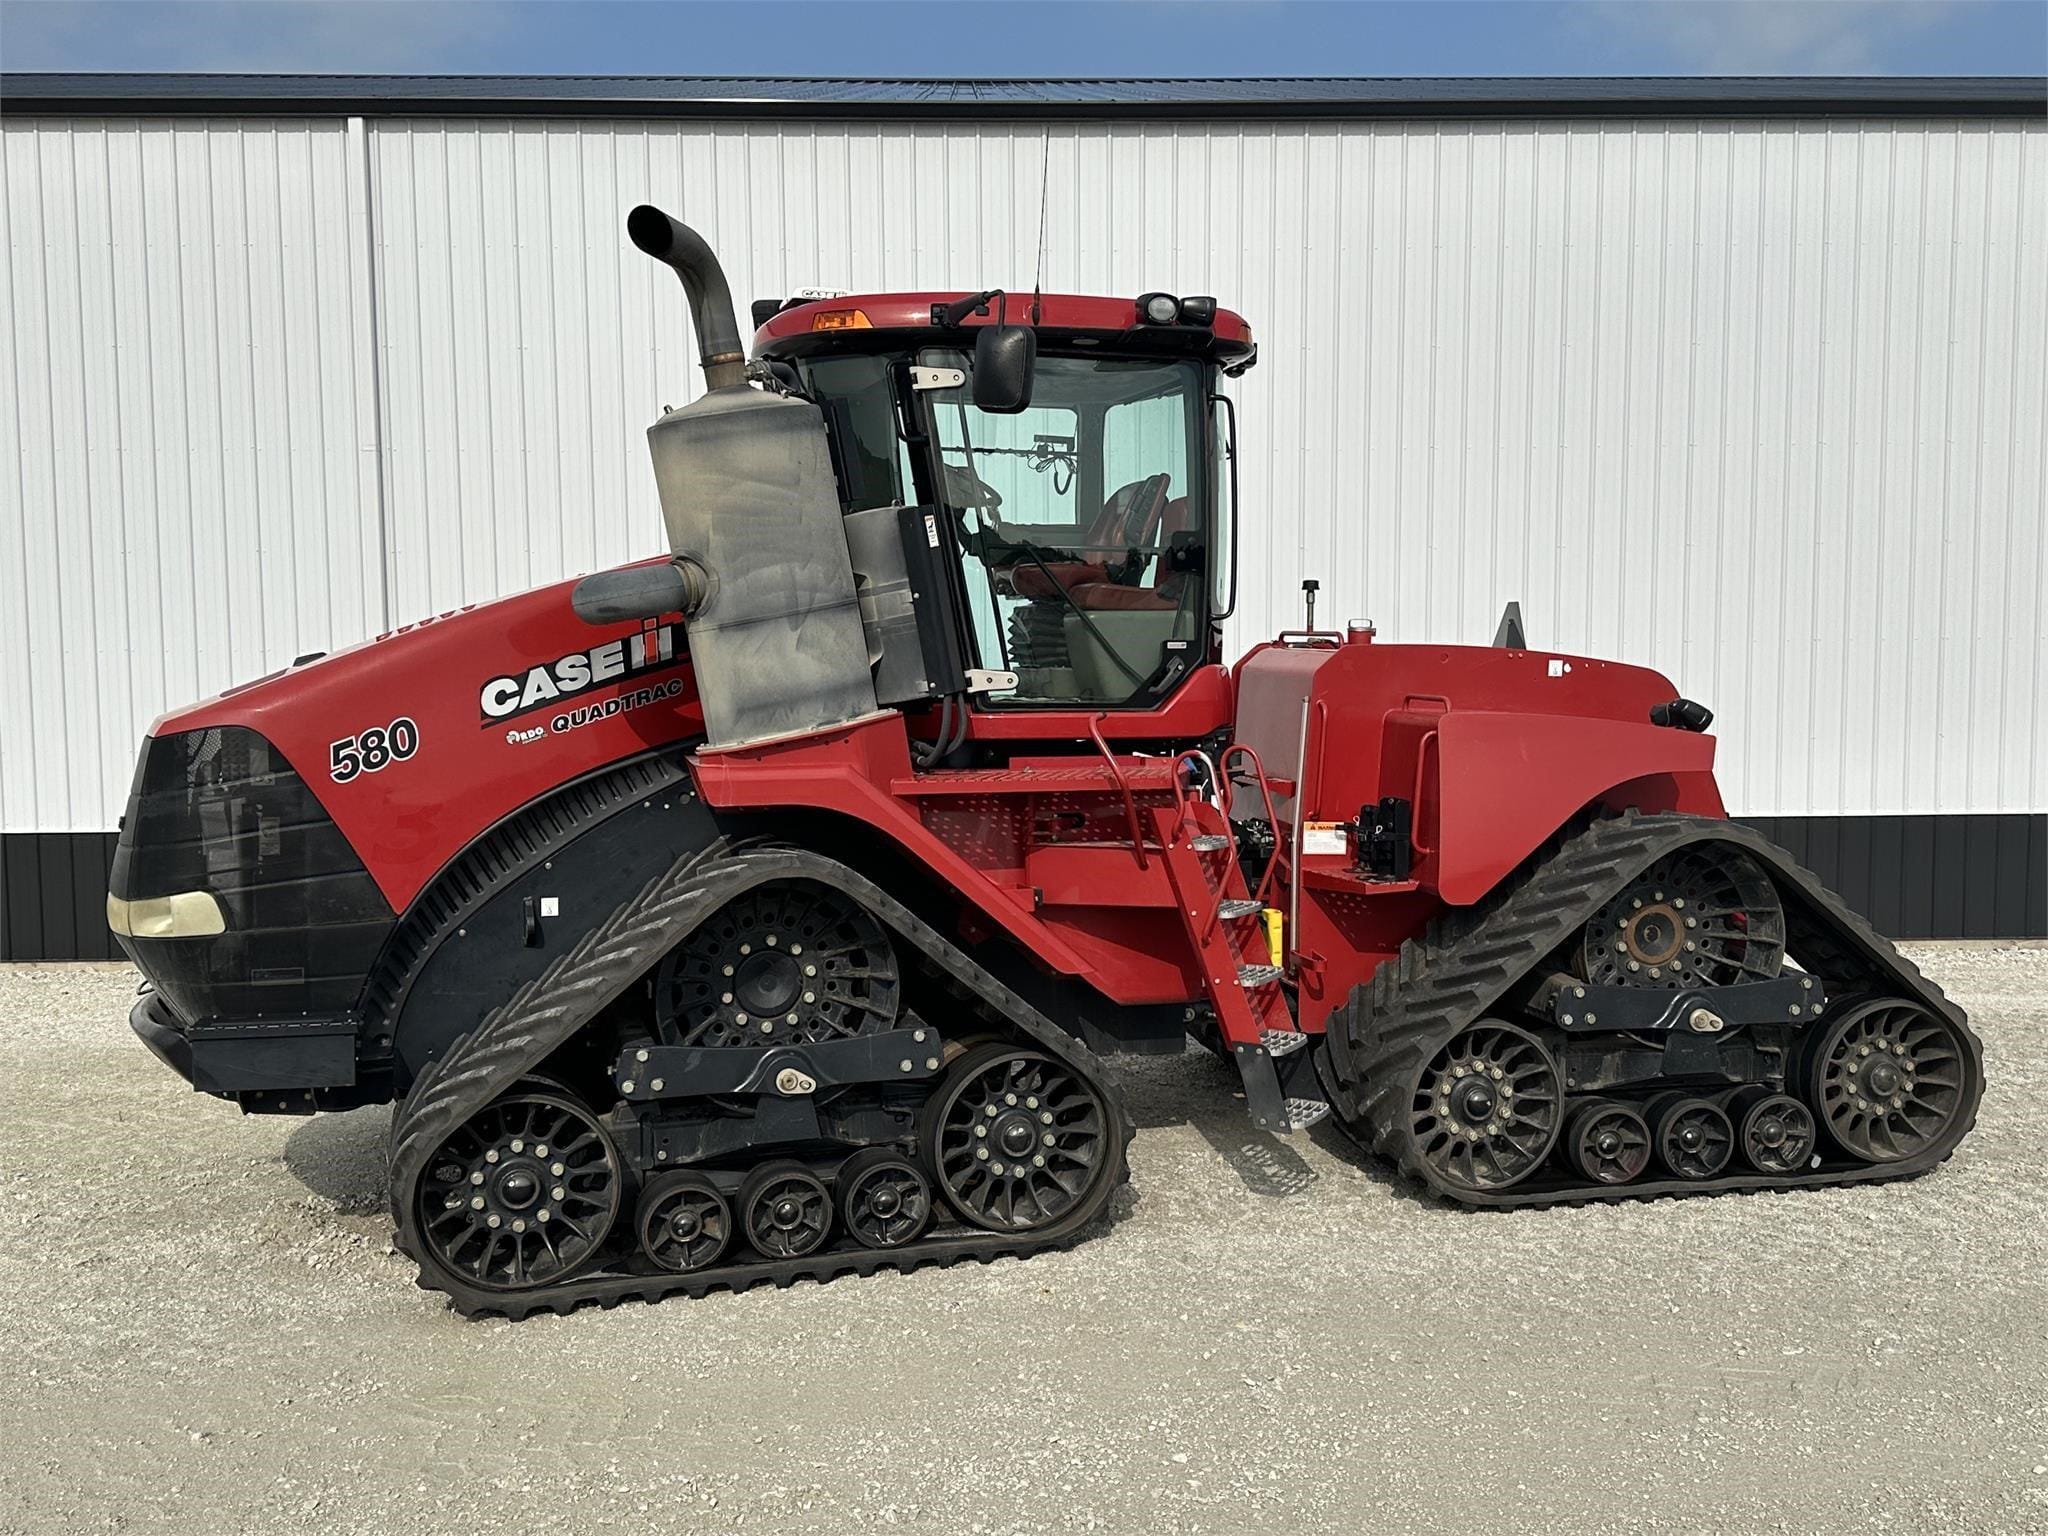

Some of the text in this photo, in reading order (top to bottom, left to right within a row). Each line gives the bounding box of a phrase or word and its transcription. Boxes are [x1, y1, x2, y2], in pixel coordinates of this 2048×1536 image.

[480, 640, 625, 717] CASE
[551, 678, 684, 734] QUADTRAC
[329, 716, 420, 784] 580
